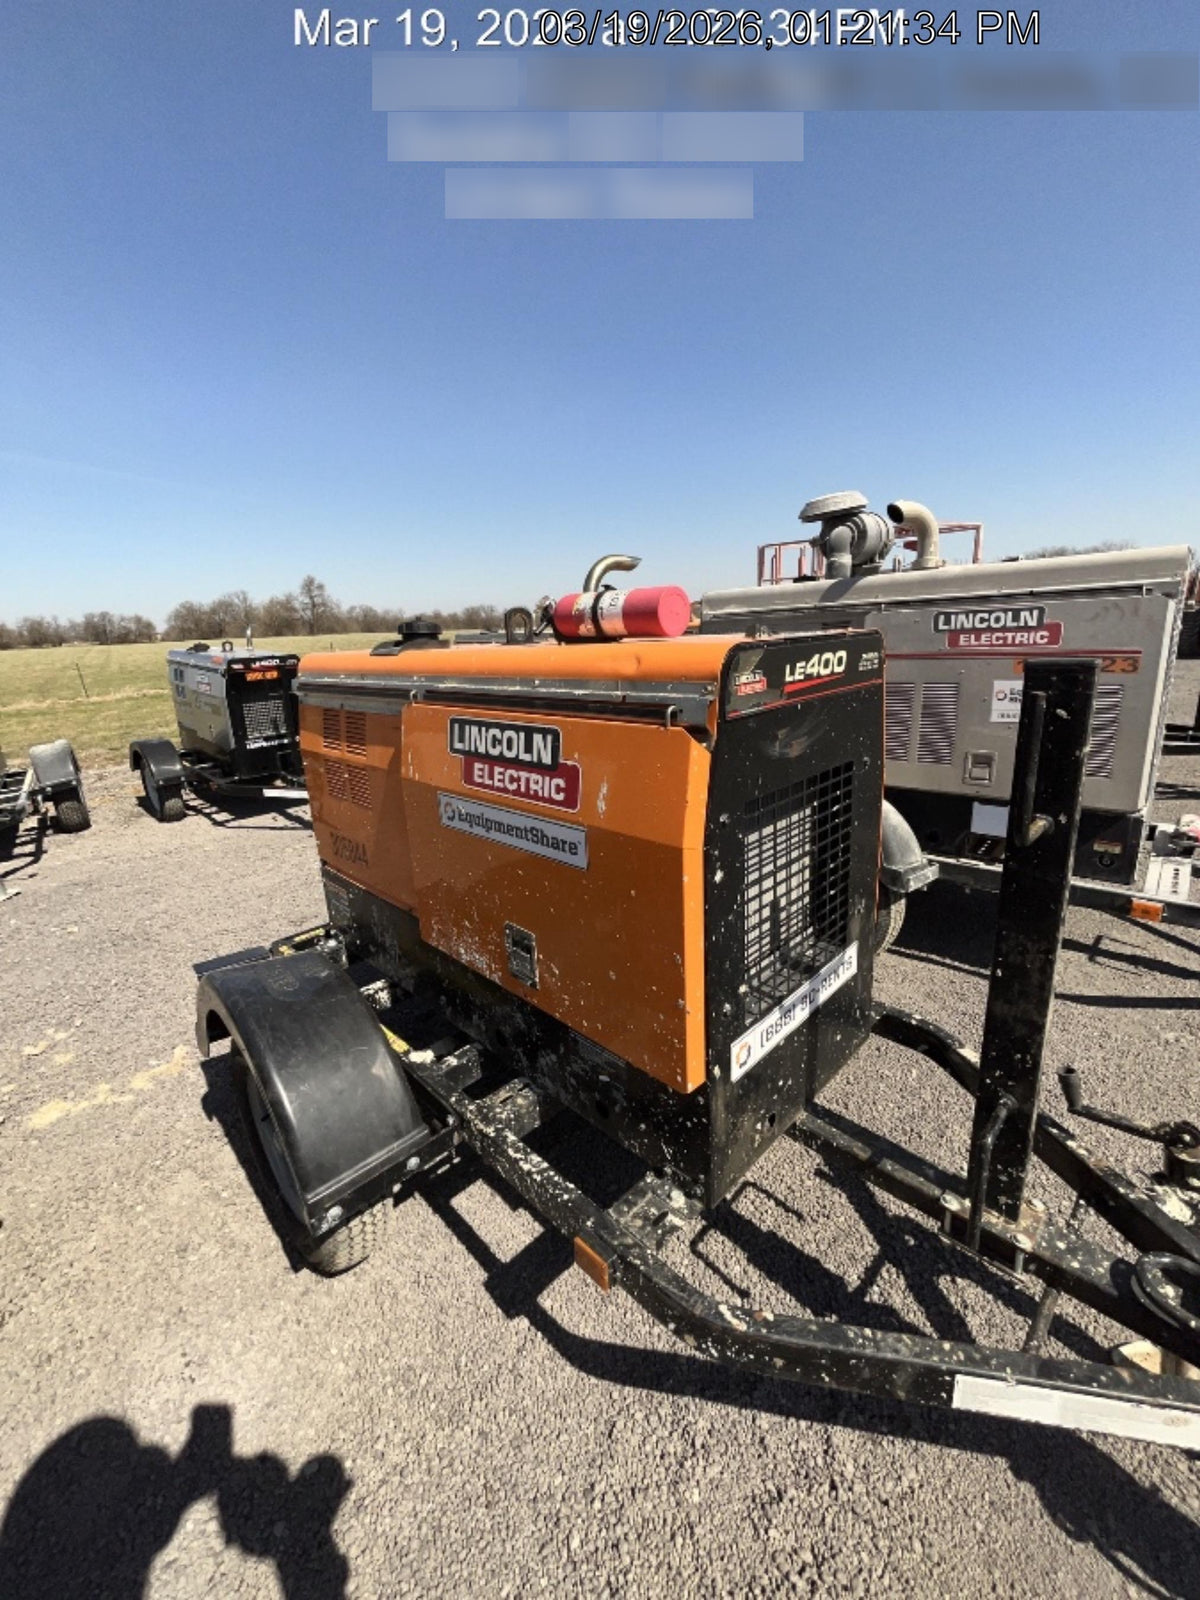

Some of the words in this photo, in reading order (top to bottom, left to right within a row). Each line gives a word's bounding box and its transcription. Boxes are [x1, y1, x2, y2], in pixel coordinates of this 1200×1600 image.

[937, 609, 1039, 630] LINCOLN
[958, 629, 1050, 646] ELECTRIC
[785, 650, 847, 682] LE400
[452, 722, 553, 766] LINCOLN
[473, 761, 566, 801] ELECTRIC
[456, 804, 579, 856] EquipmentShare
